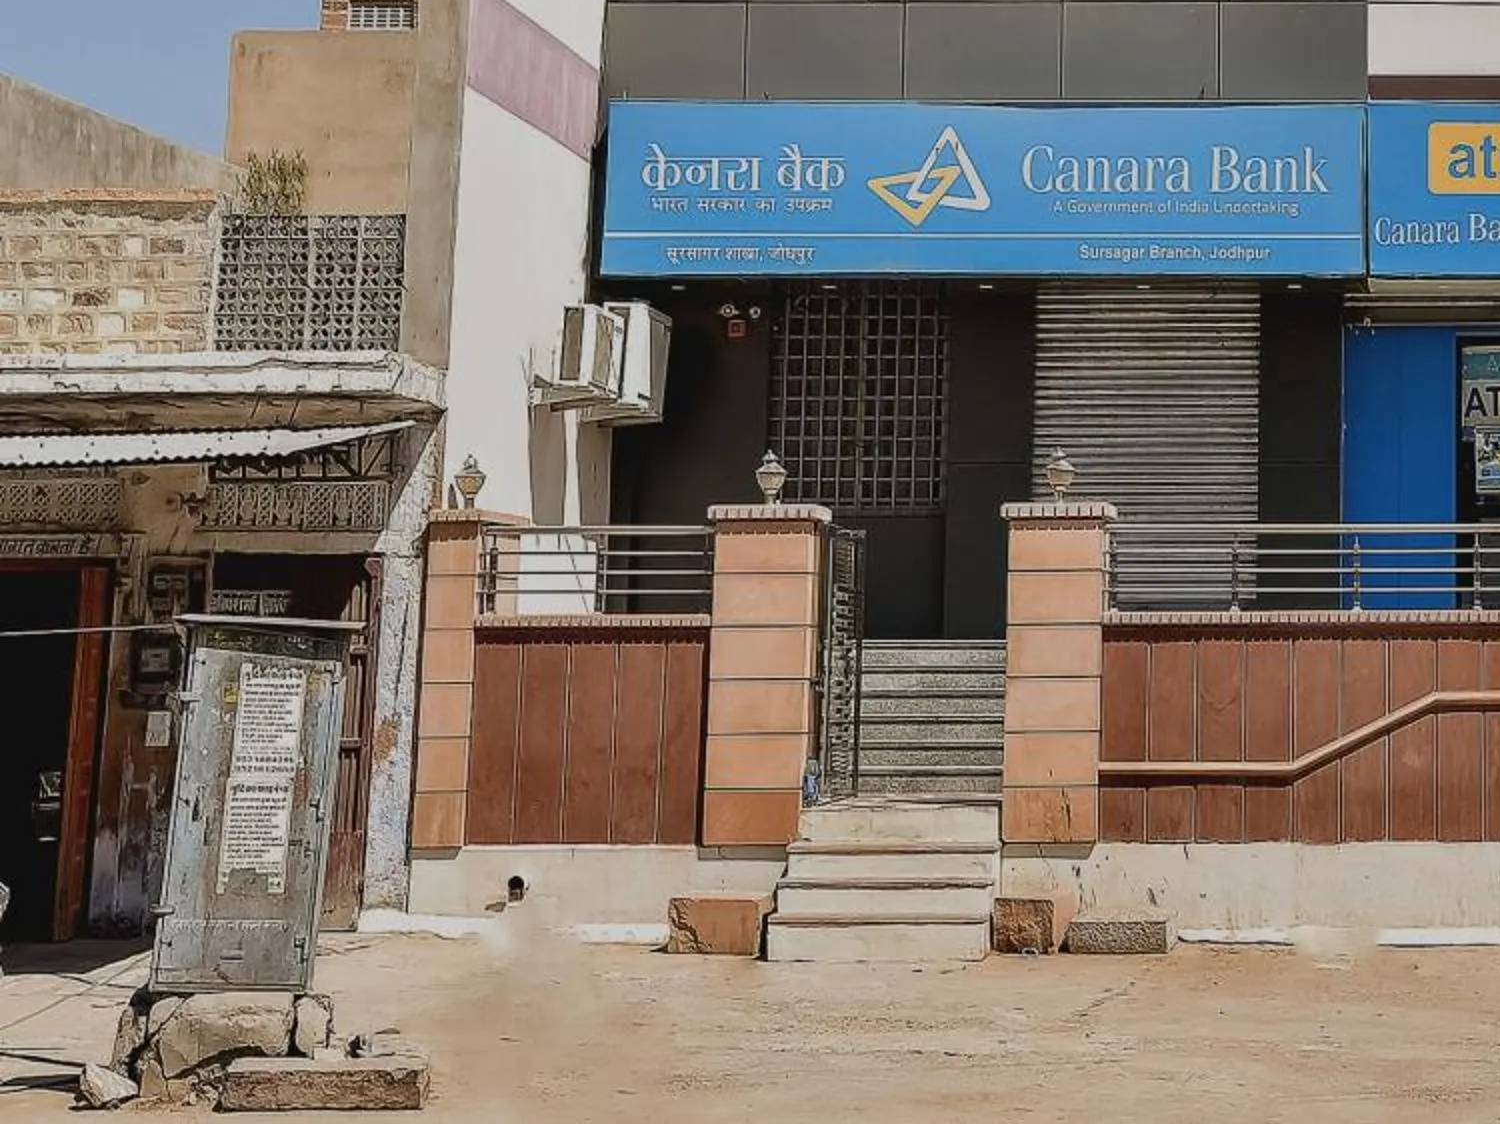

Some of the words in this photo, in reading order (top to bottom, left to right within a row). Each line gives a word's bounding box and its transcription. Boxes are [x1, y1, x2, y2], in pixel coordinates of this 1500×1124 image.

[641, 143, 764, 192] केनरा
[1021, 143, 1191, 194] Canara
[1209, 144, 1330, 194] Bank
[651, 195, 689, 213] भारत
[697, 195, 745, 213] सरकार
[753, 195, 776, 213] का
[783, 195, 833, 215] उपक्रम
[1053, 200, 1064, 213] A
[1067, 199, 1155, 213] Government
[1157, 199, 1172, 213] of
[1175, 199, 1209, 213] India
[1213, 199, 1299, 217] Undertaking
[1373, 216, 1461, 246] Canara
[1078, 243, 1146, 261] Sursagar
[1149, 243, 1205, 261] Branch,
[1209, 243, 1271, 261] Jodhpur
